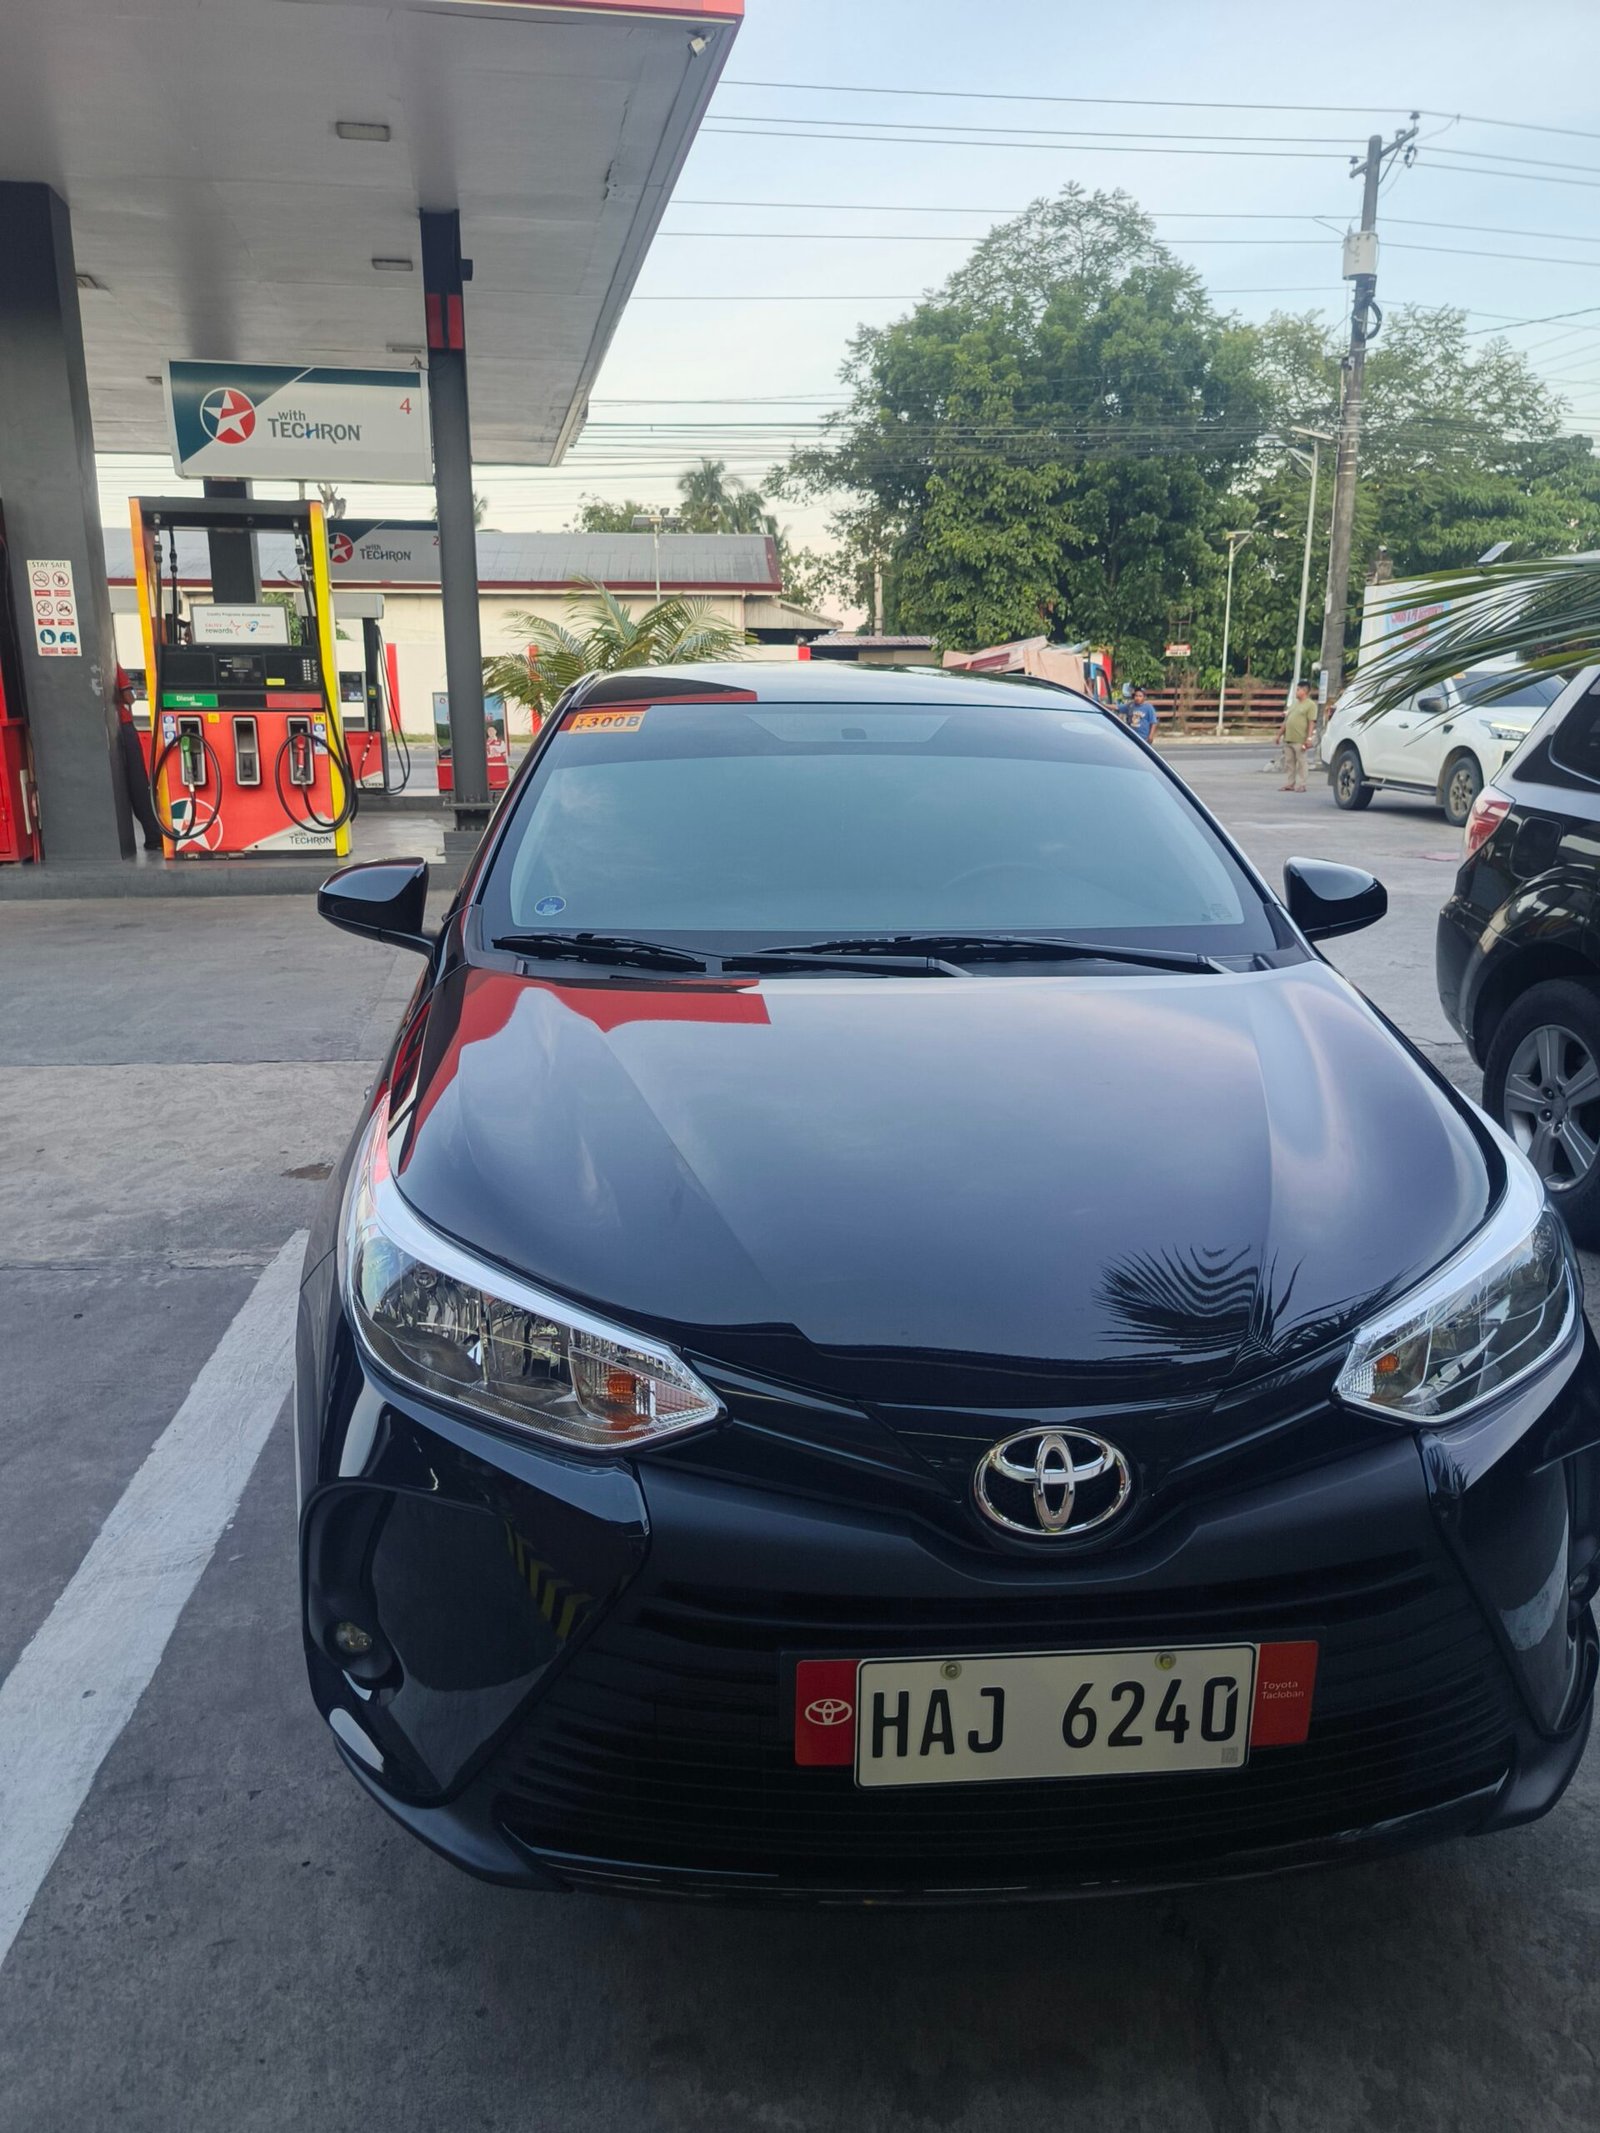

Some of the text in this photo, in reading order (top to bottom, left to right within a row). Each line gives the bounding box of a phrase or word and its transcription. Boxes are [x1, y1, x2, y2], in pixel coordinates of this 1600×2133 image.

[400, 398, 412, 415] 4
[278, 409, 306, 421] with
[267, 418, 361, 444] TECHRON
[432, 535, 440, 547] 2
[359, 548, 411, 562] TECHRON
[289, 836, 332, 845] TECHRON
[1262, 1681, 1299, 1690] Toyota
[1261, 1690, 1305, 1700] Tacloban
[872, 1676, 1239, 1758] HAJ 6240
